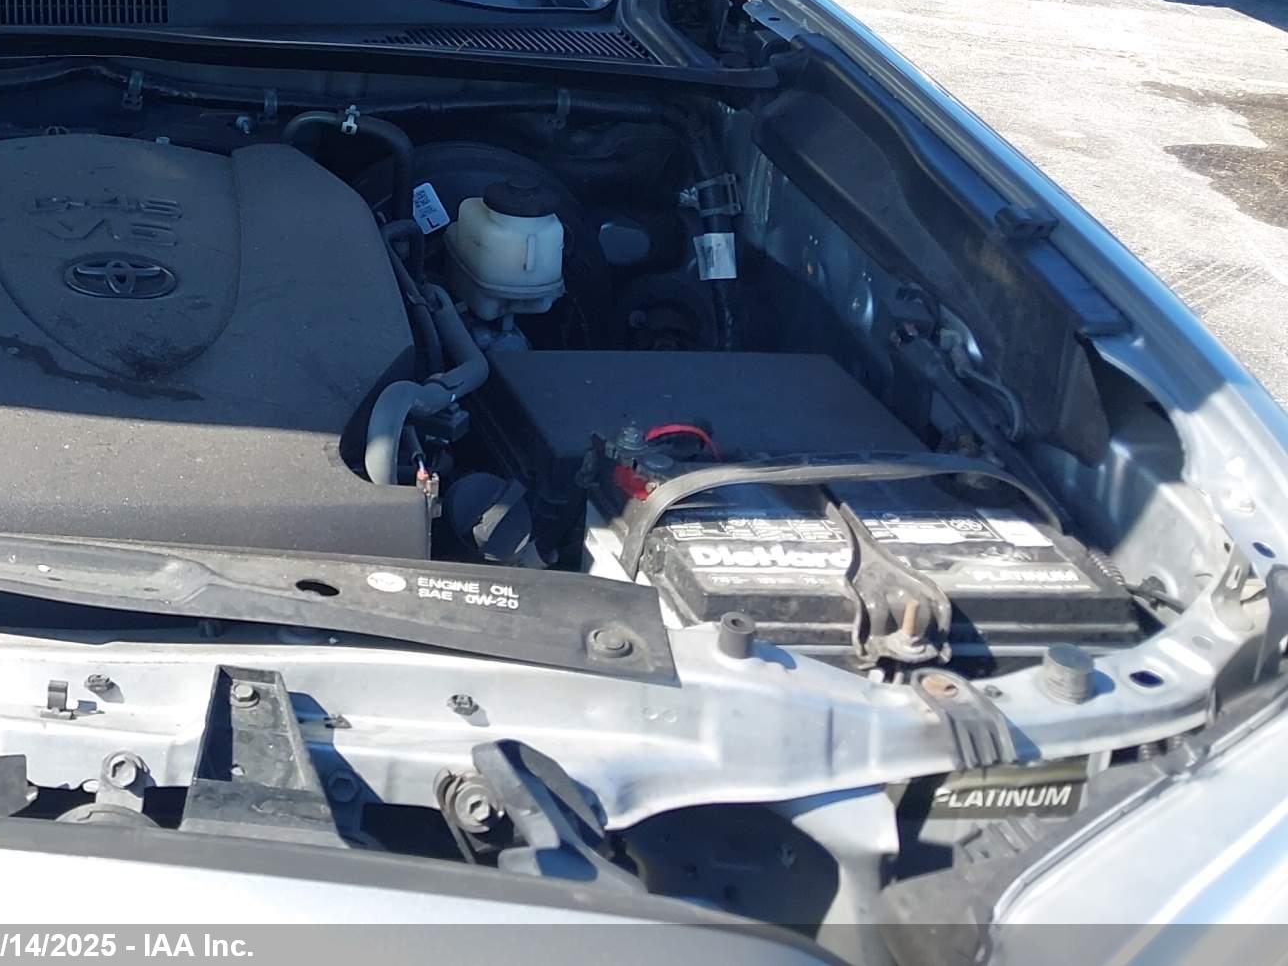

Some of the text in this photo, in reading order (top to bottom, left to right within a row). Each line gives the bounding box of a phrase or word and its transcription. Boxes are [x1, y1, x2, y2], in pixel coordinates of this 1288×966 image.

[689, 544, 853, 568] DieHard
[417, 577, 520, 599] ENGINE OIL
[417, 587, 520, 610] SAE 0W-20
